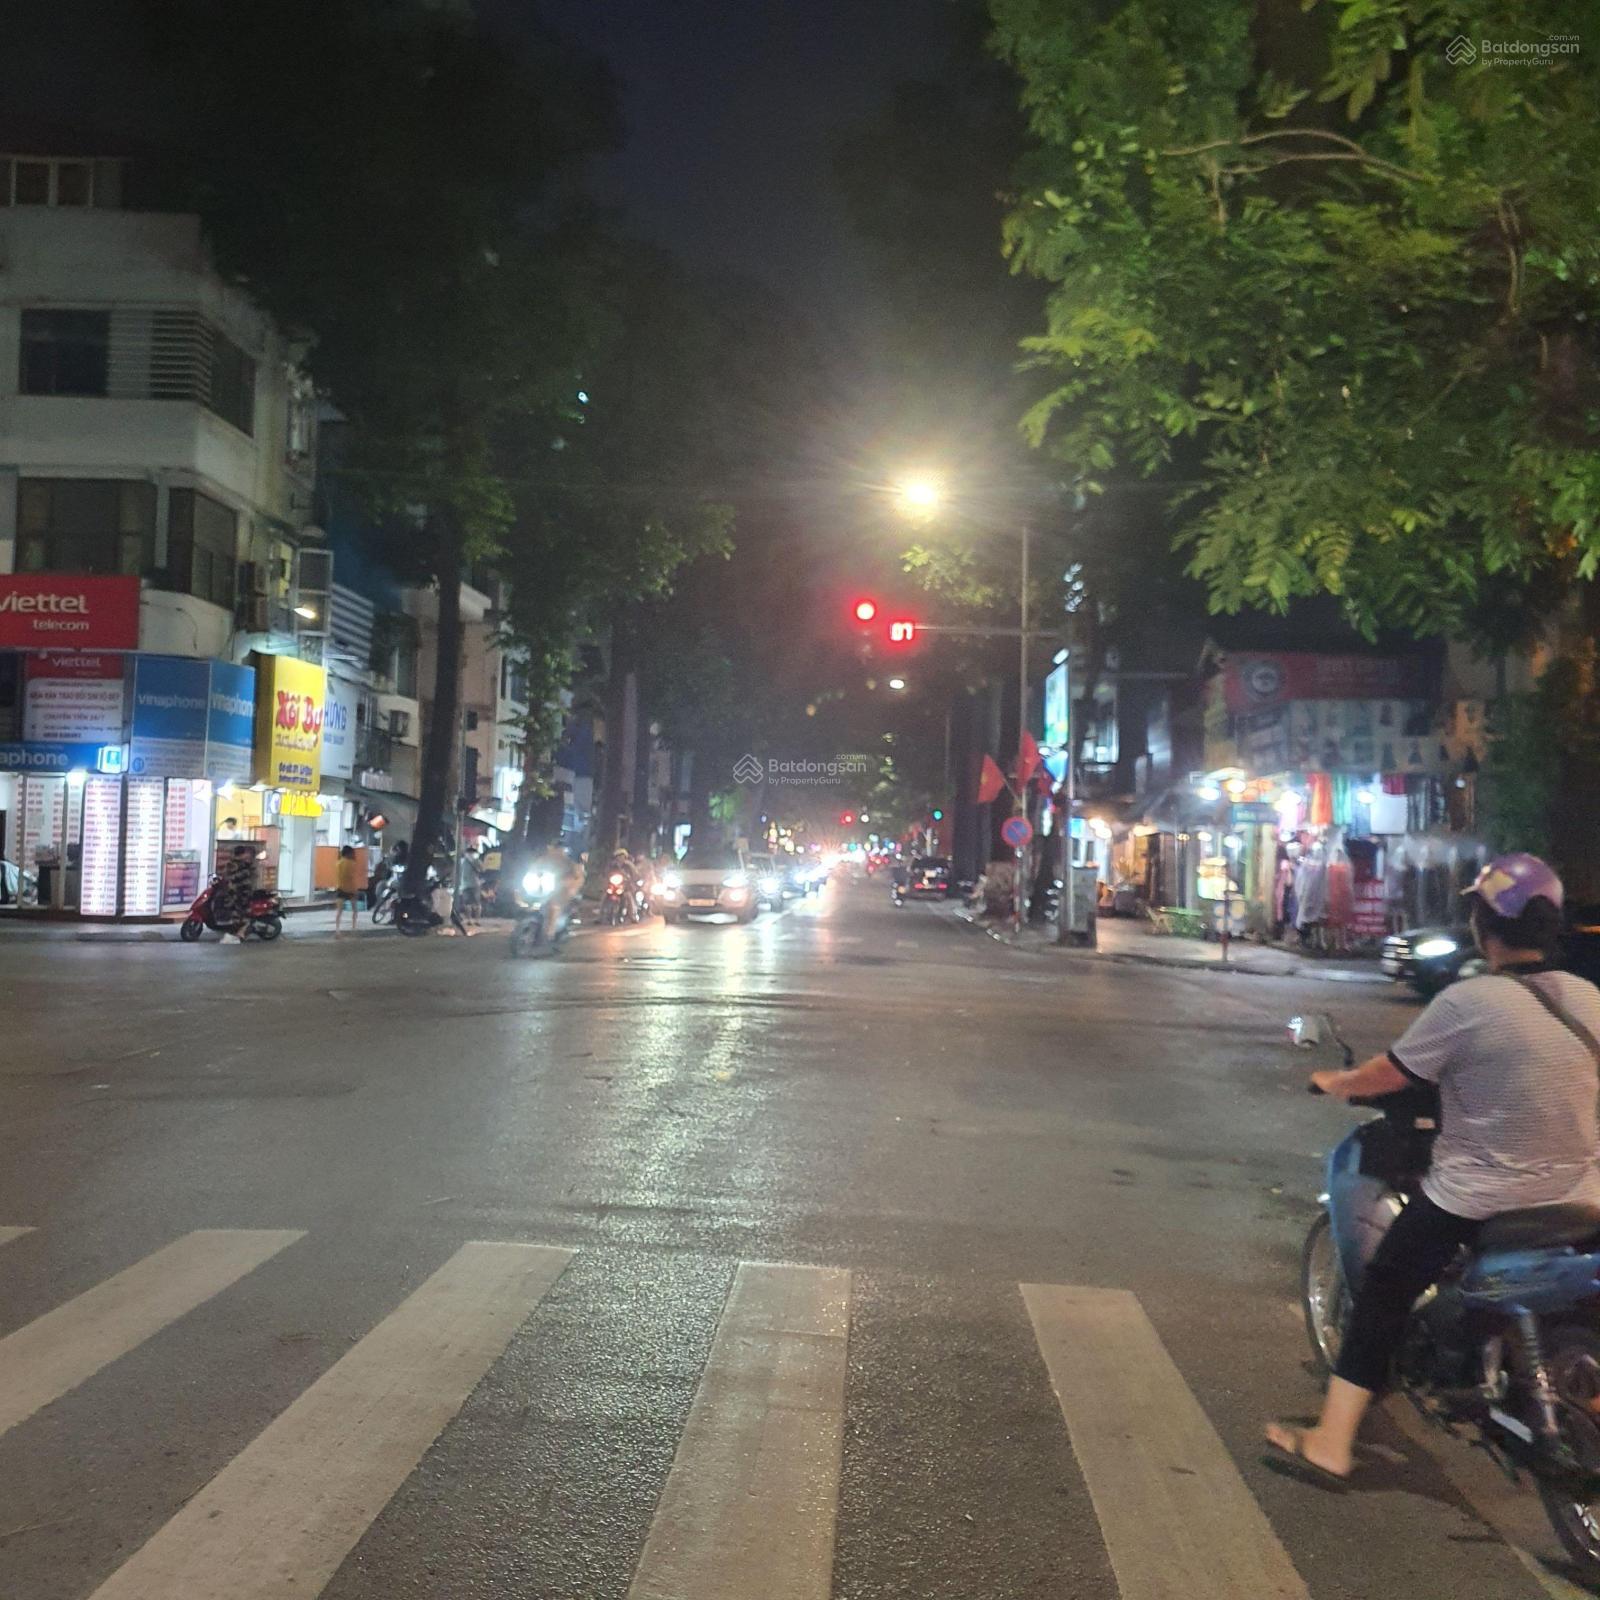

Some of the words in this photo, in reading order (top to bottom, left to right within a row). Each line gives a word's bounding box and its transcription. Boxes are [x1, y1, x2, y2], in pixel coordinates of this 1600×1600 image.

[33, 620, 89, 631] telecom
[52, 656, 102, 668] viettel
[138, 693, 206, 710] vinaphone
